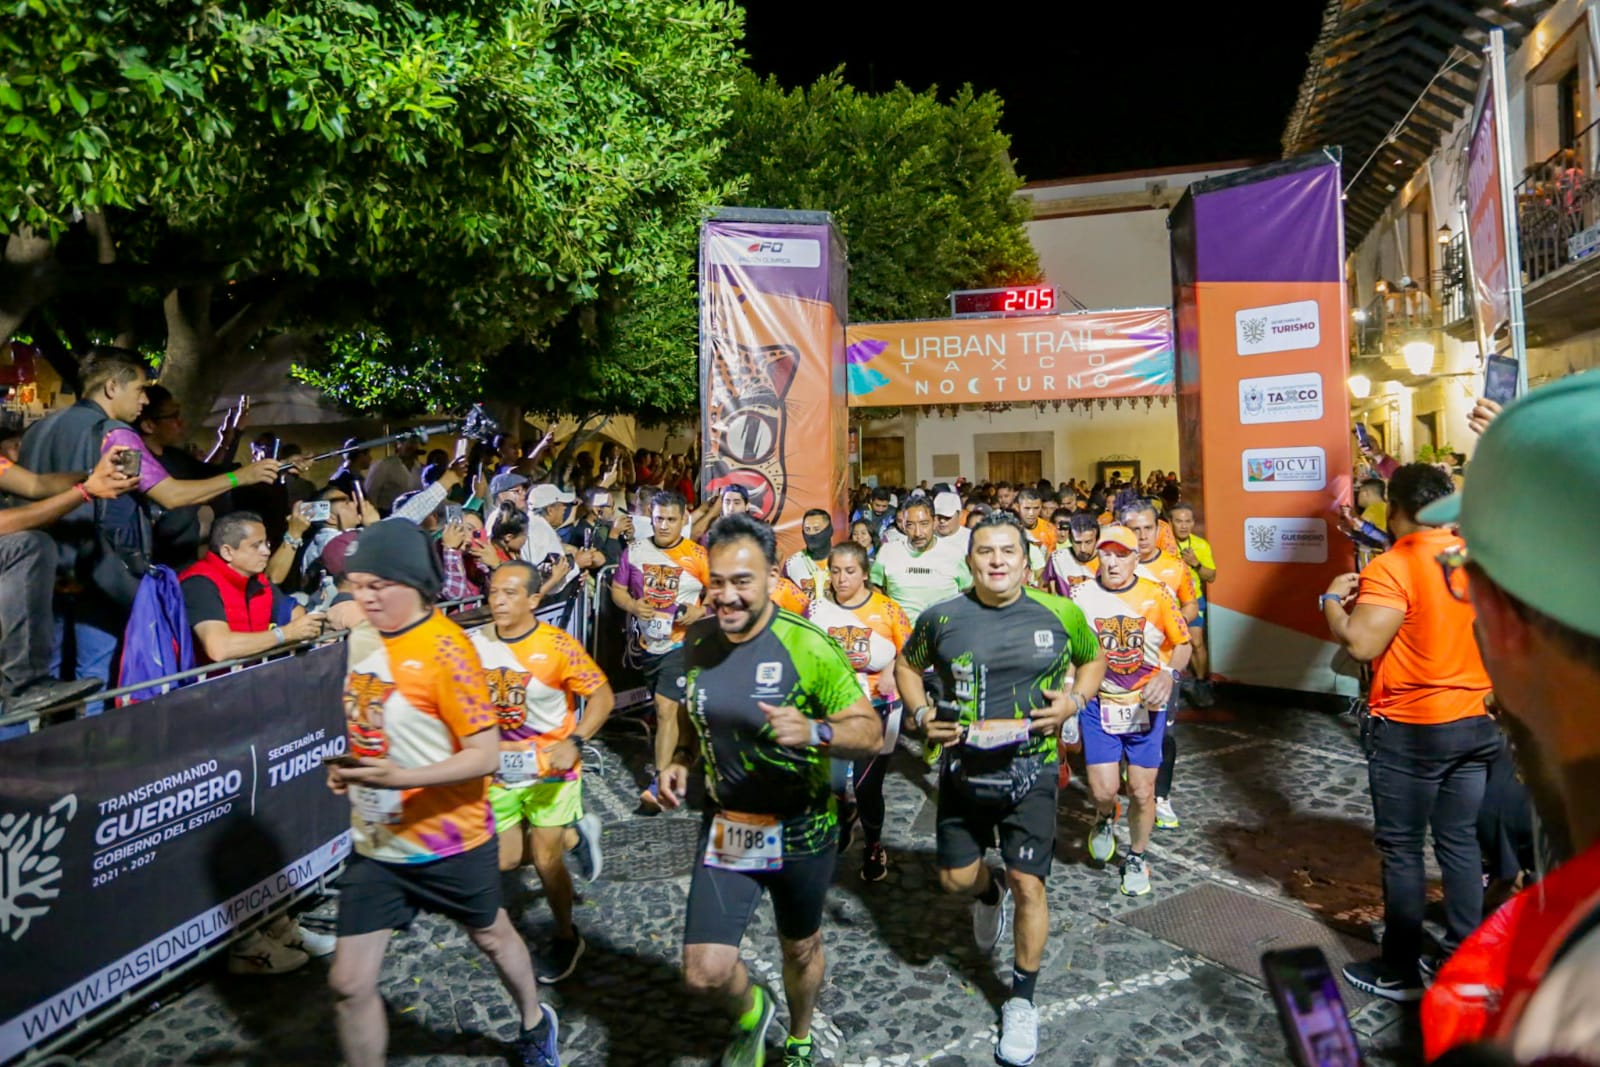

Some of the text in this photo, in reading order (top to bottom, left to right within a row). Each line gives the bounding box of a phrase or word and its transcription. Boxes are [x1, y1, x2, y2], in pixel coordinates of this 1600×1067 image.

[1271, 321, 1316, 334] TURISMO
[900, 333, 1006, 359] URBAN
[1275, 458, 1318, 472] OCVT
[1118, 707, 1132, 721] 13
[268, 729, 326, 761] SECRETARÍA DE
[267, 735, 347, 788] TURISMO
[98, 759, 218, 816] TRANSFORMANDO
[95, 769, 243, 846] GUERRERO
[93, 803, 232, 871] GOBIERNO DEL ESTADO
[727, 826, 765, 850] 1188
[92, 869, 119, 888] 2021
[130, 852, 157, 870] 2027
